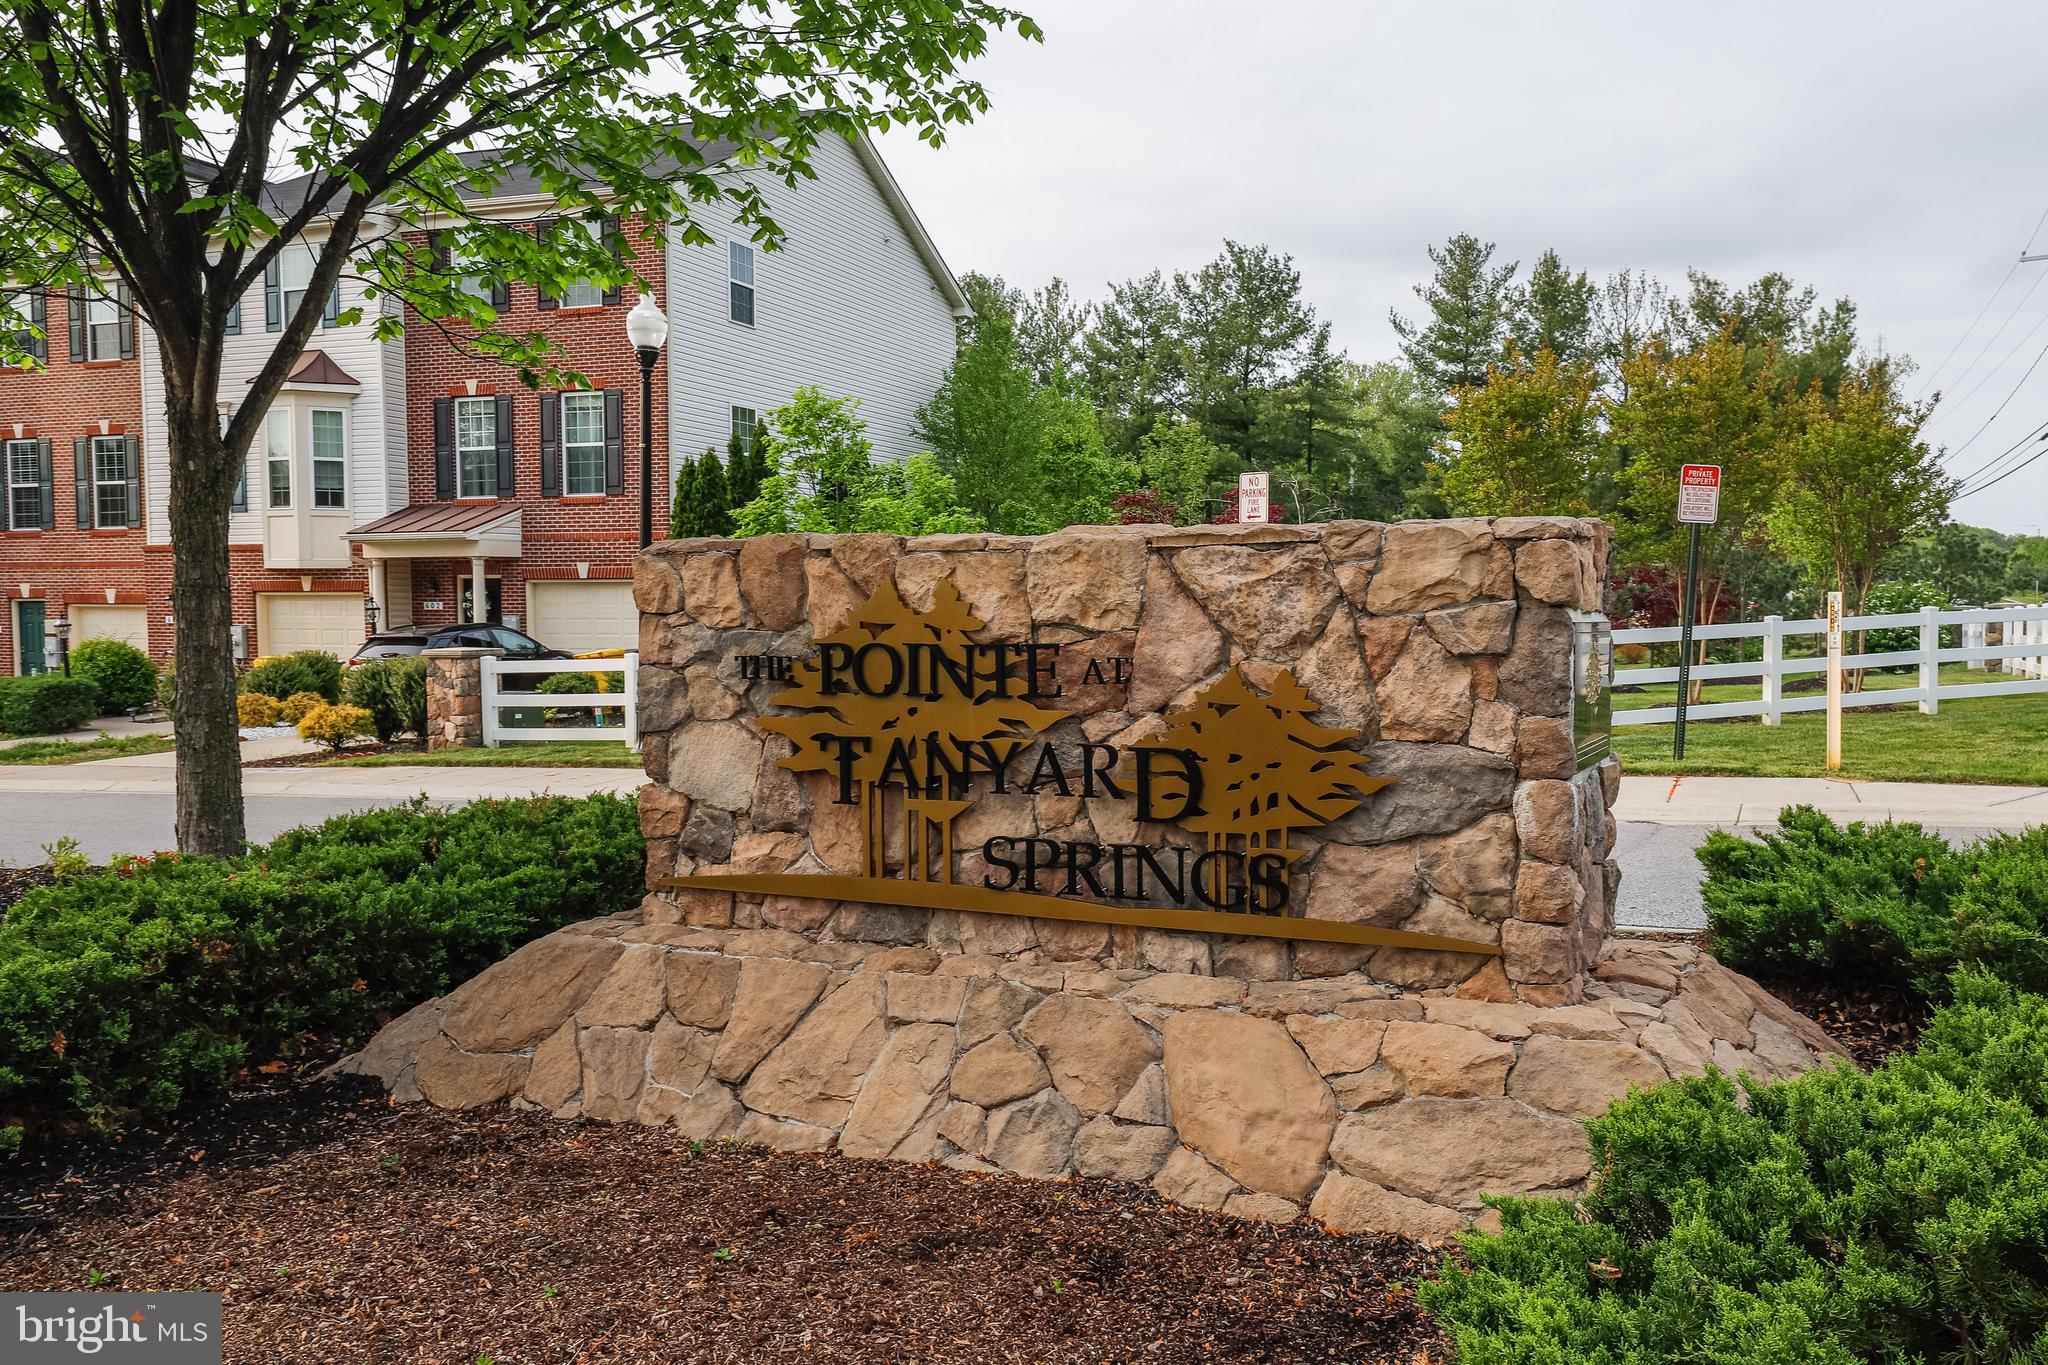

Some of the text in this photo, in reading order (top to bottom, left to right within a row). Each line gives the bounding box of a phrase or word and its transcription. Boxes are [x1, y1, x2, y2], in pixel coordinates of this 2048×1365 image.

[1688, 469, 1713, 478] PRIVATE
[1248, 477, 1260, 487] NO
[1684, 477, 1716, 485] PROPERTY
[1242, 488, 1266, 498] PARKING
[735, 642, 1133, 699] THE POINTE AT
[810, 732, 1205, 824] TANYARD
[982, 836, 1290, 912] SPRINGS
